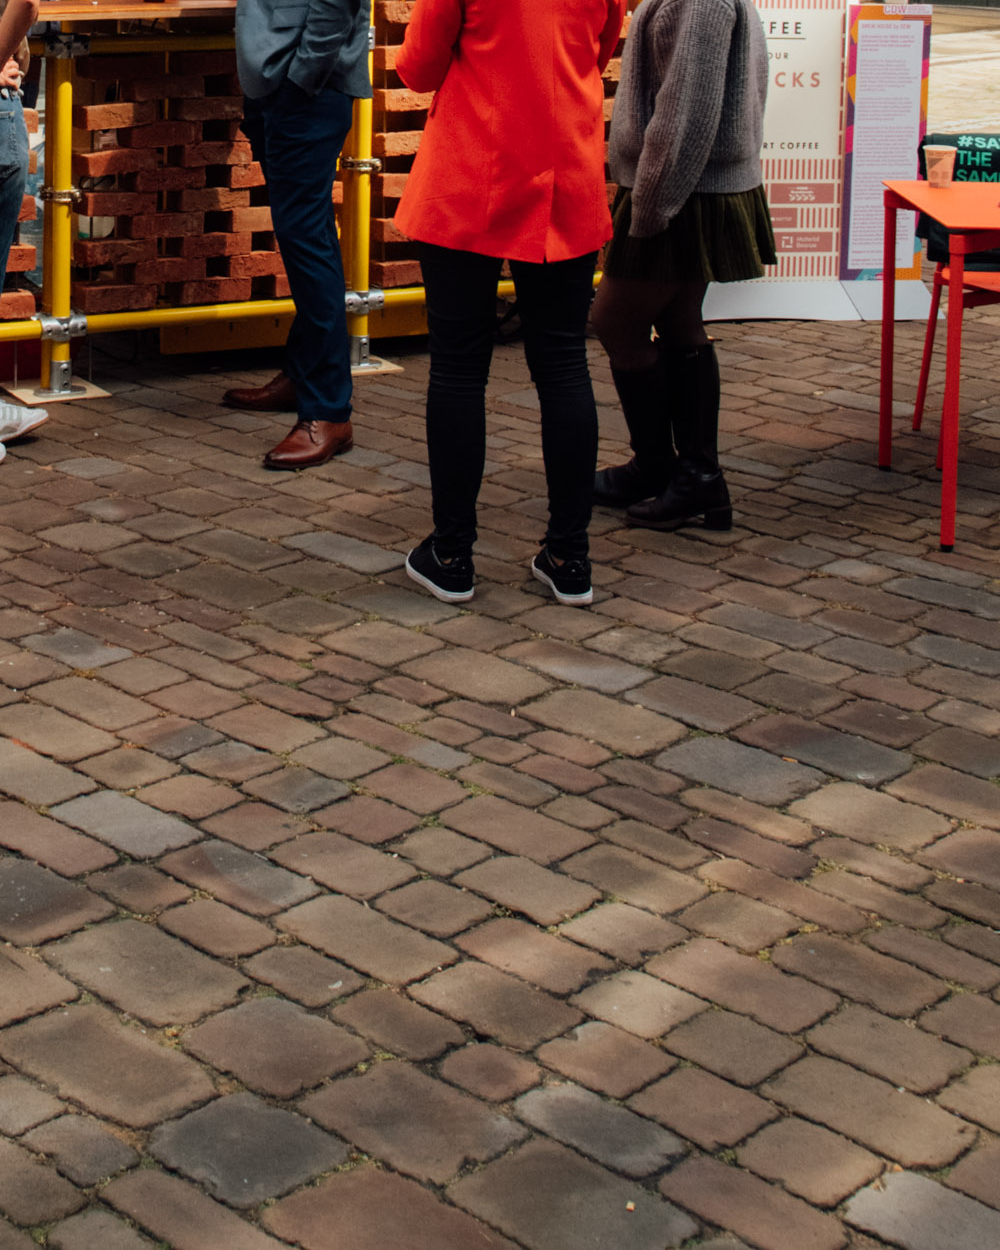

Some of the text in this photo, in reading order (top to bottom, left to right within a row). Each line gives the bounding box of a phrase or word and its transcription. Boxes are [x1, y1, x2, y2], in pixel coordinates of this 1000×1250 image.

[761, 21, 802, 34] FEE
[774, 72, 820, 88] CKS
[957, 135, 1000, 150] #SA
[957, 150, 993, 167] THE
[956, 168, 1000, 182] SAM
